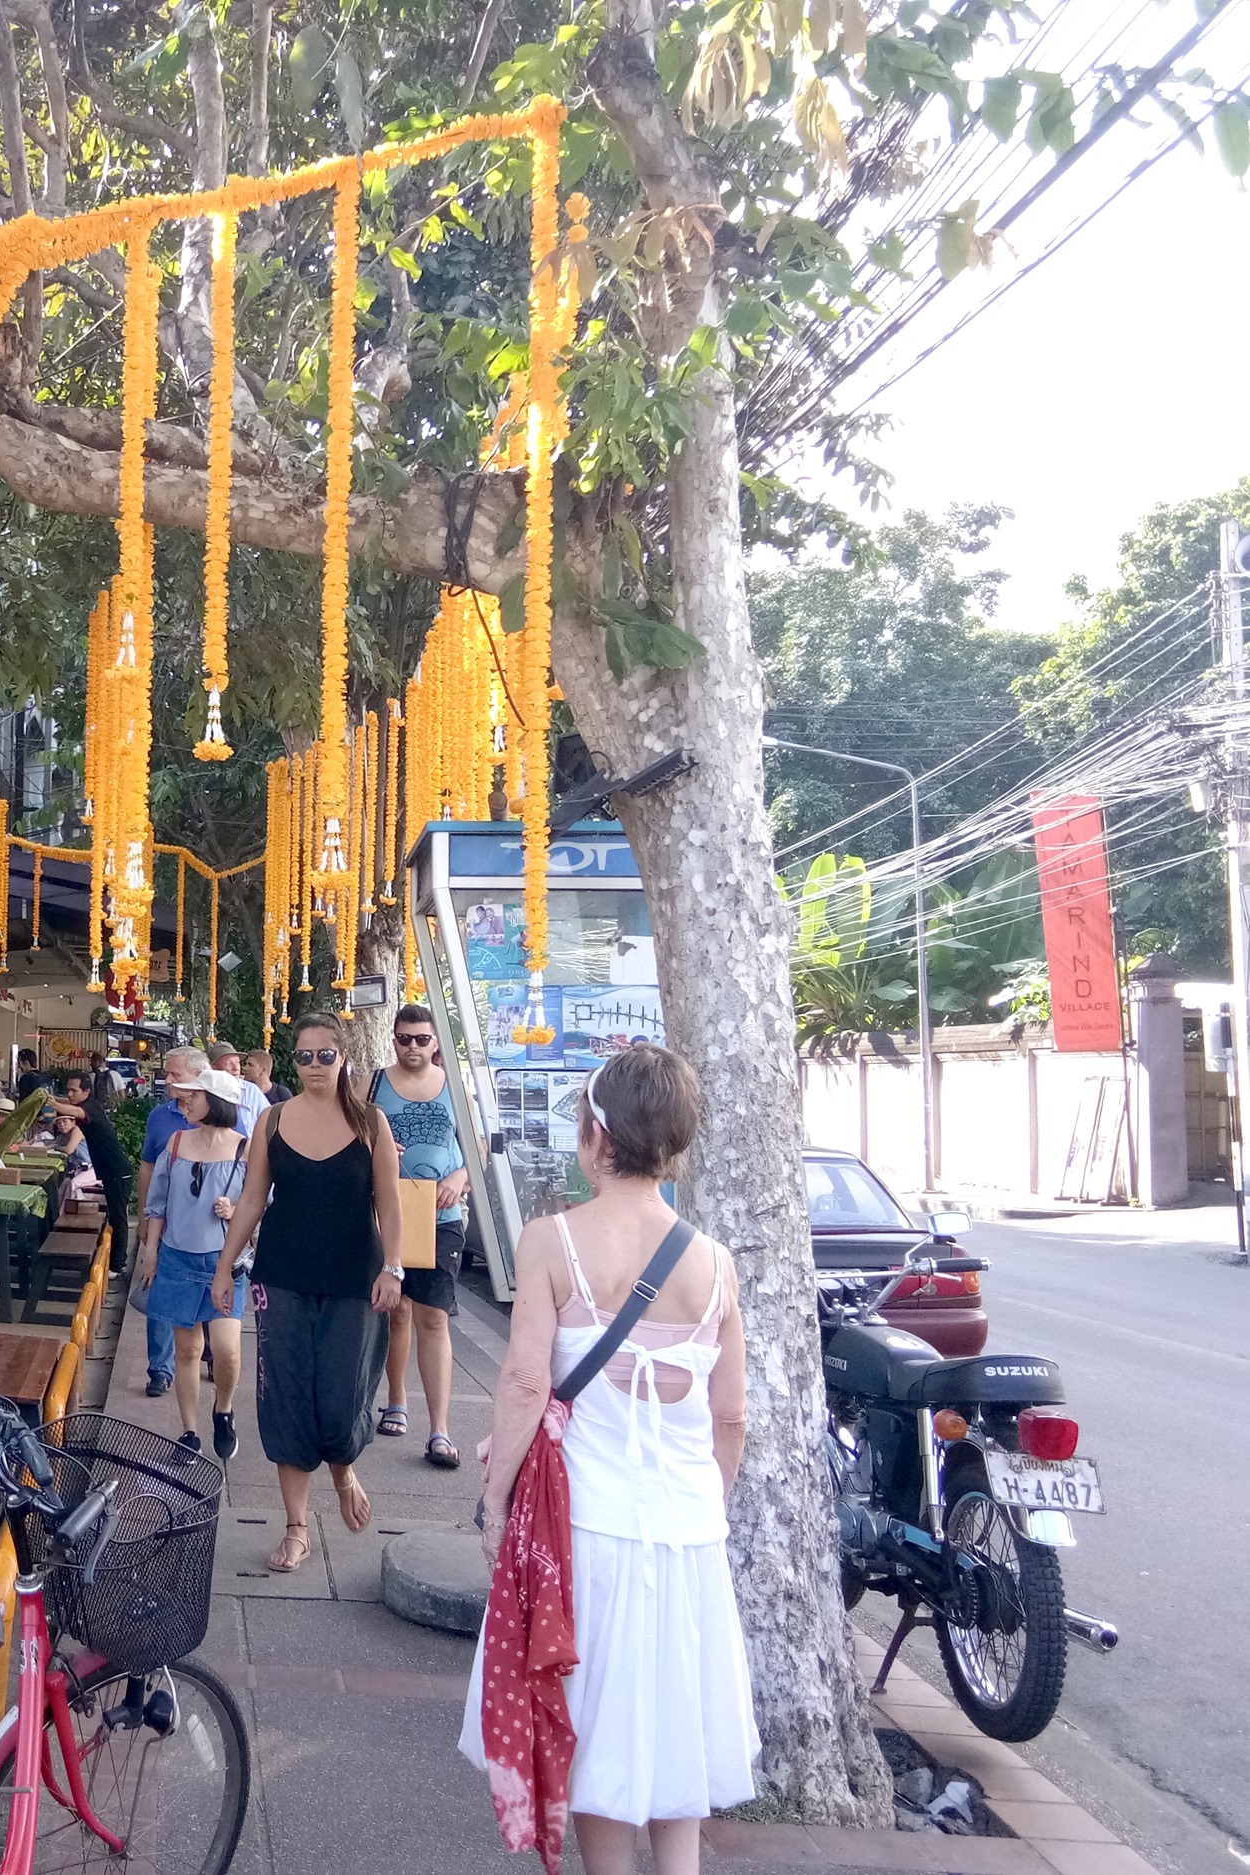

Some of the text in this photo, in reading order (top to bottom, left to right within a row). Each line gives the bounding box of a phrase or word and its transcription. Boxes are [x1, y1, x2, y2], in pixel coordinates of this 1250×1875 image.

[500, 842, 630, 870] OT
[1059, 809, 1092, 998] TAMARIND
[1058, 1002, 1110, 1012] VILLAGE
[823, 1355, 847, 1371] SUZUKI
[983, 1366, 1049, 1377] SUZUKI
